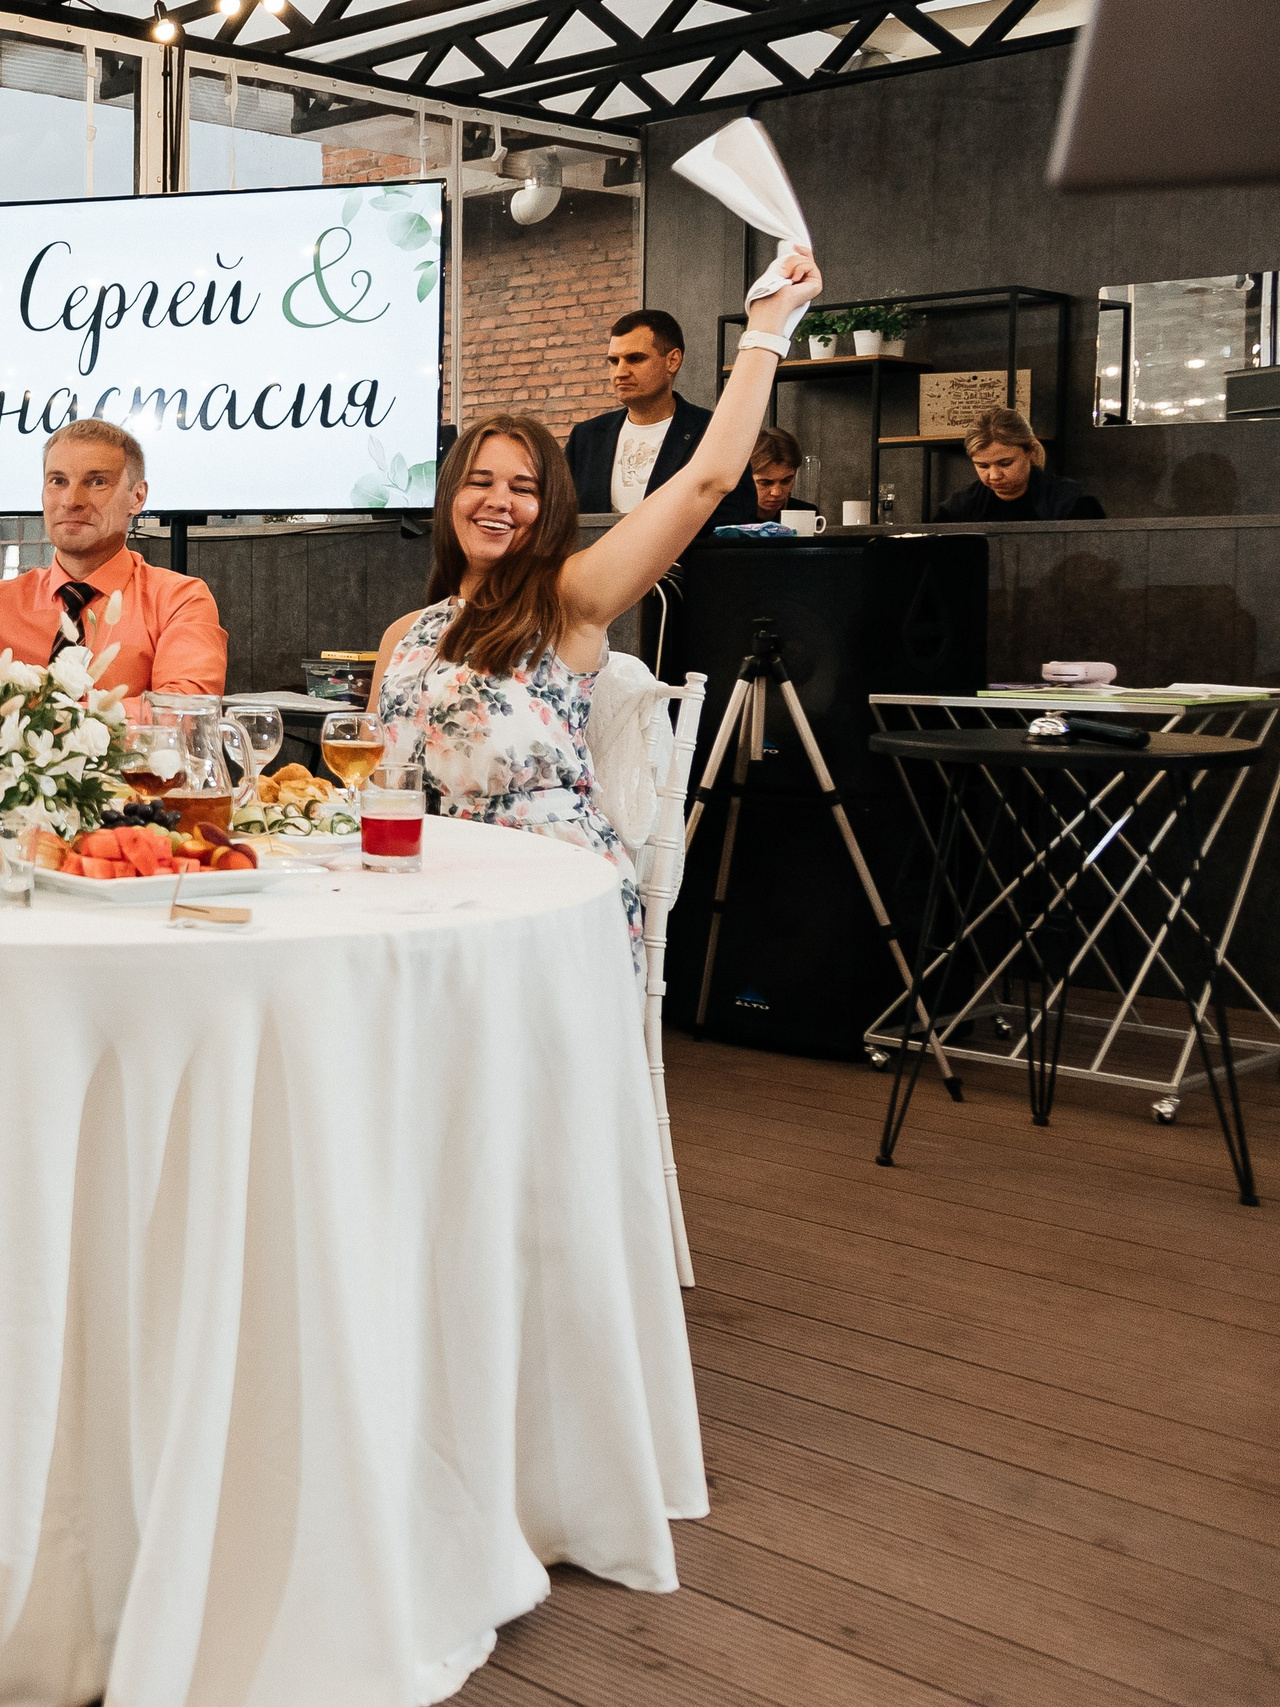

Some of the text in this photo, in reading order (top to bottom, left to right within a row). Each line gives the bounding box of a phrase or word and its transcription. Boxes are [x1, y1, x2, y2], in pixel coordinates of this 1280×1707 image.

[19, 226, 391, 376] Сергей &
[735, 1000, 770, 1010] ALTO
